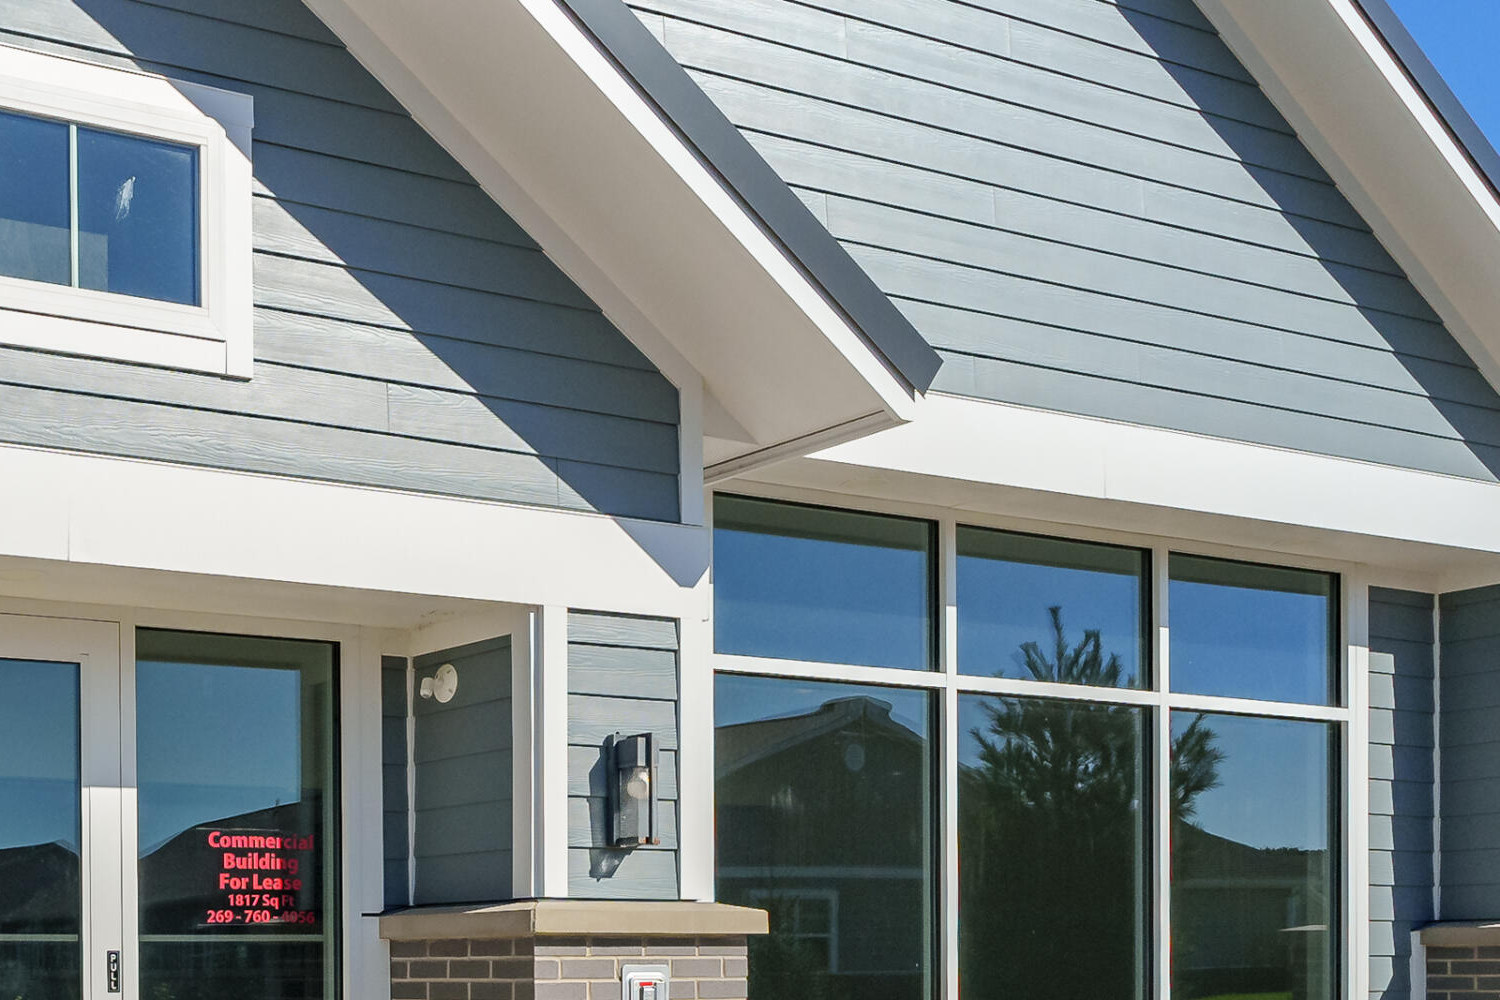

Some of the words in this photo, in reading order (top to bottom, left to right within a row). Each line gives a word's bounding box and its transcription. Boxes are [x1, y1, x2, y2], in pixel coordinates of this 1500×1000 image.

[207, 831, 314, 850] Commercial
[222, 852, 299, 874] Building
[218, 873, 249, 890] For
[252, 873, 303, 891] Lease
[227, 894, 260, 907] 1817
[261, 894, 280, 910] Sq
[109, 953, 117, 990] PULL
